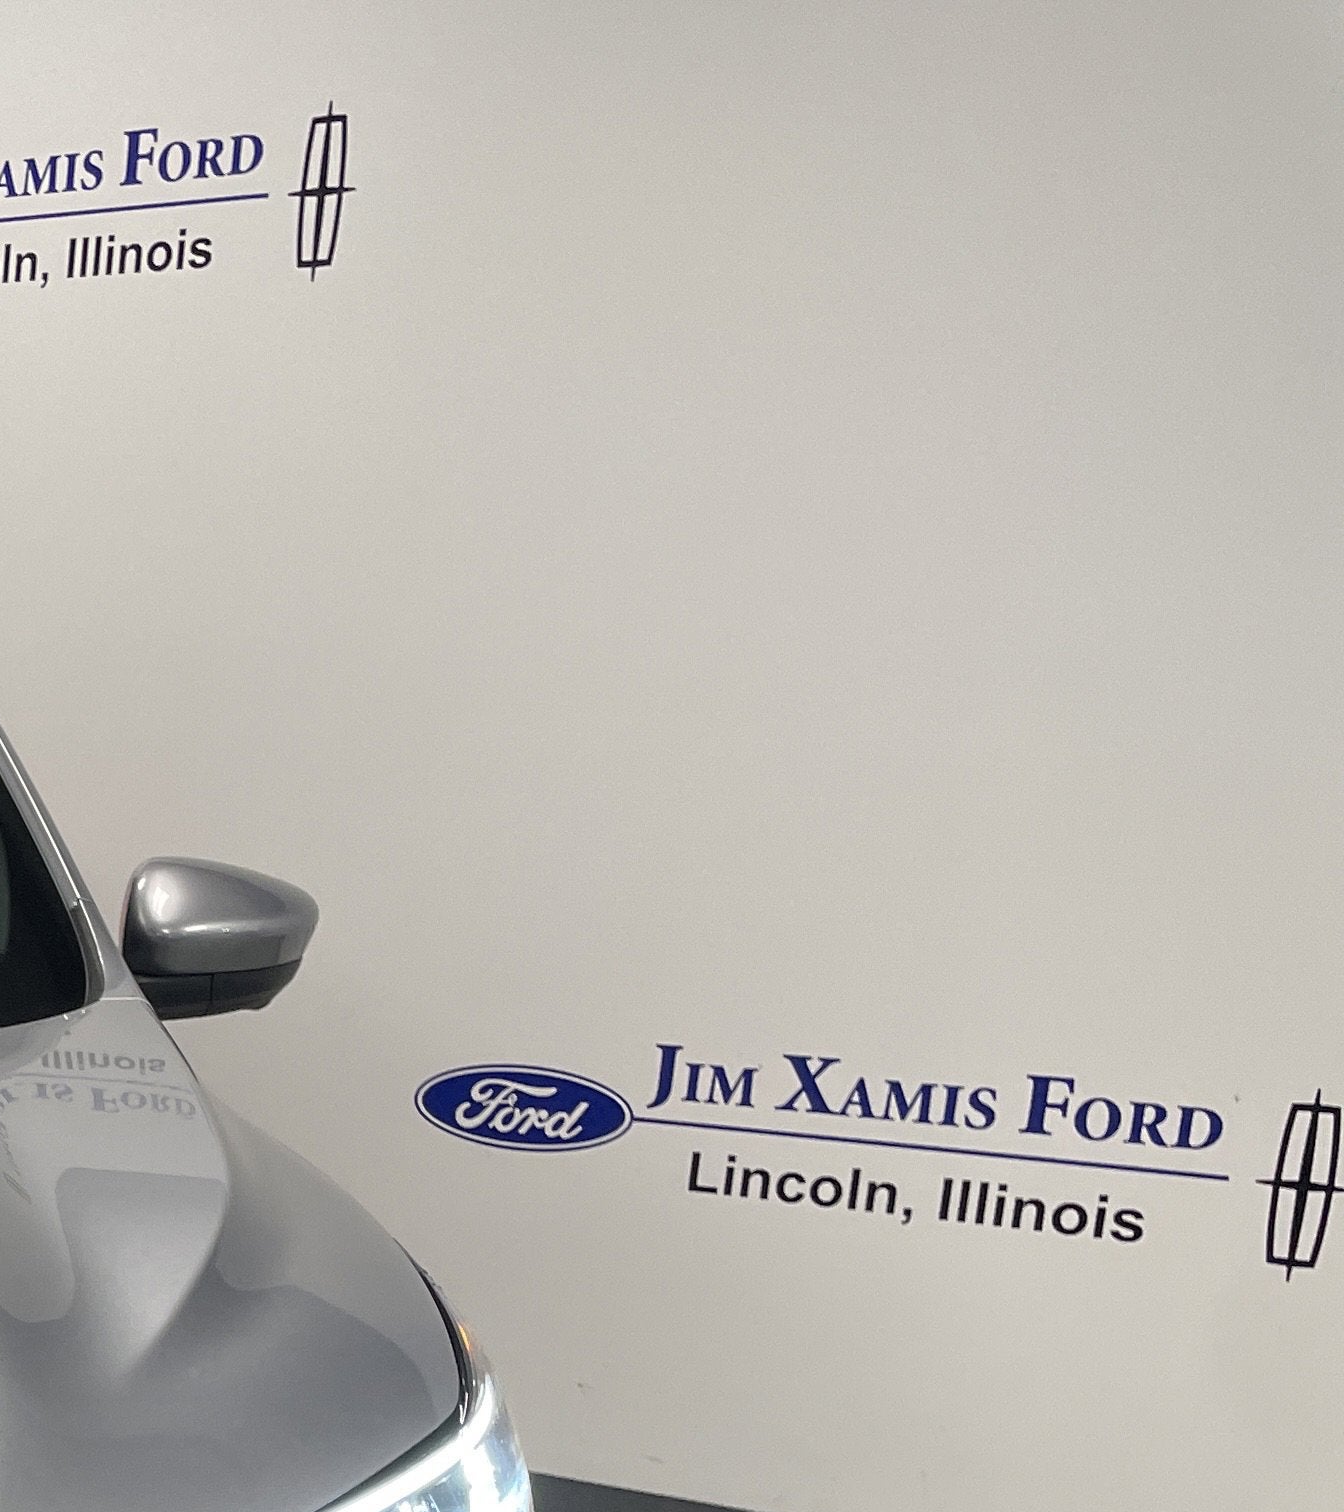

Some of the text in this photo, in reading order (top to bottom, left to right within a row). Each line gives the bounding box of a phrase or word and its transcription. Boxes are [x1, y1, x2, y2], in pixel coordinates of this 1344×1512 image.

[119, 128, 264, 188] FORD
[66, 228, 214, 279] Illinois
[450, 1079, 589, 1142] Ford
[646, 1043, 1224, 1151] JIM XAMIS FORD
[685, 1152, 1146, 1244] Lincoln, Illinois
